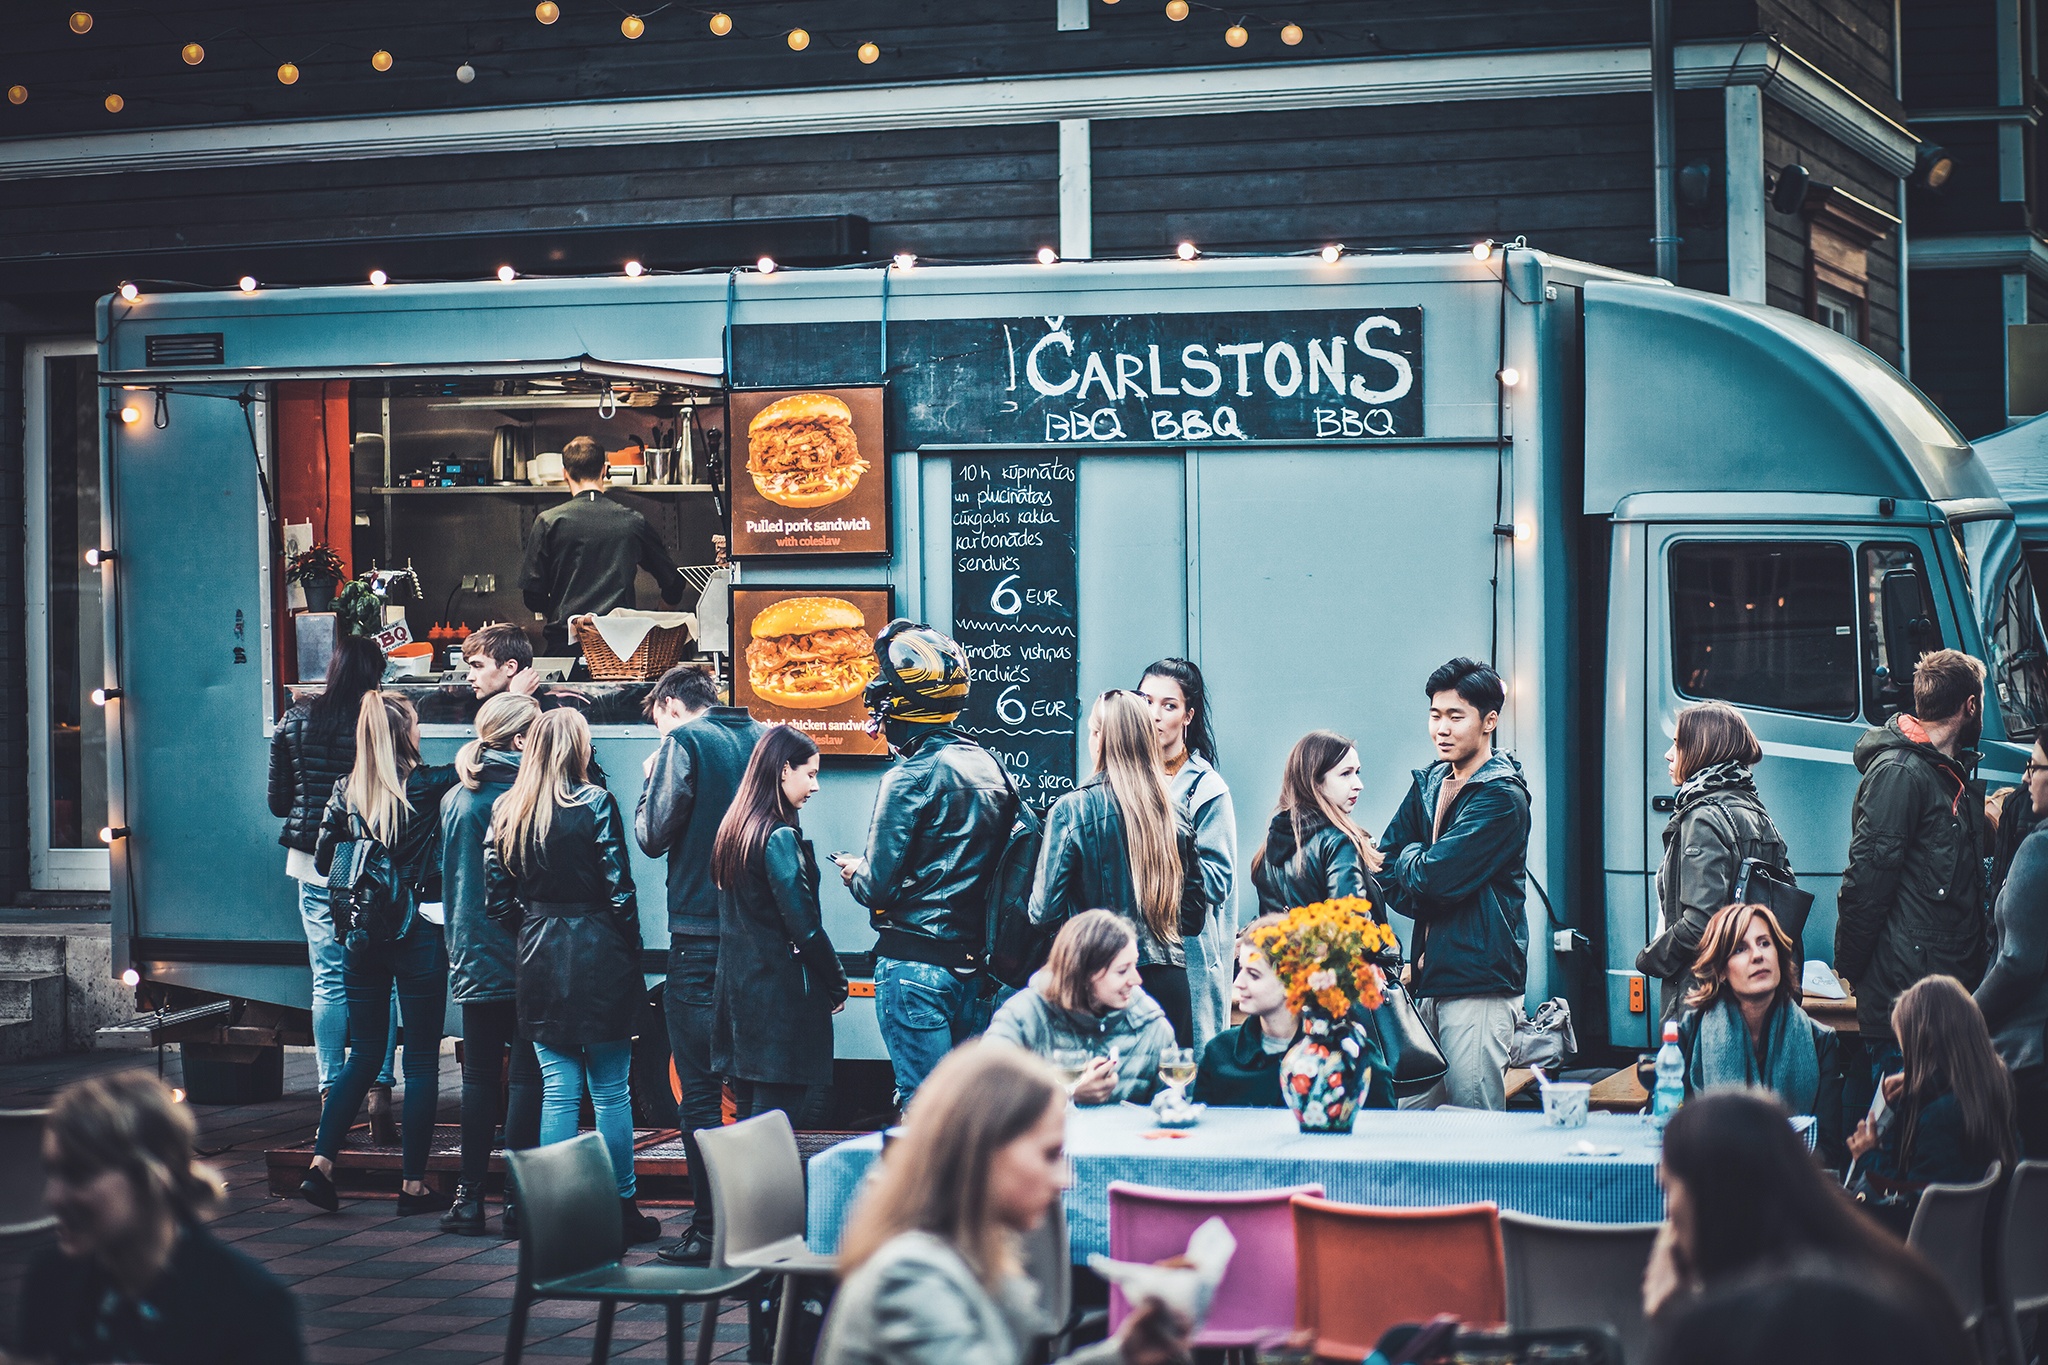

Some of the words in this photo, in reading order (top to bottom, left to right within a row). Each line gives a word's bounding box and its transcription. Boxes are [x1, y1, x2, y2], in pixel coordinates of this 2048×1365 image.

[1045, 408, 1127, 442] BBQ
[1151, 406, 1248, 441] BBQ
[1313, 407, 1398, 438] BBQ
[954, 493, 969, 503] un
[746, 519, 783, 533] Pulled
[785, 518, 813, 535] pork
[814, 517, 871, 532] sandwich
[775, 536, 798, 547] with
[799, 535, 840, 547] coleslaw
[990, 574, 1022, 615] 6
[1026, 588, 1063, 606] EUR
[970, 664, 1031, 683] endvičs
[996, 684, 1026, 725] 6
[1031, 699, 1074, 720] EUR
[828, 719, 865, 731] sandwi
[812, 734, 844, 745] leslaw
[1038, 769, 1077, 790] siera
